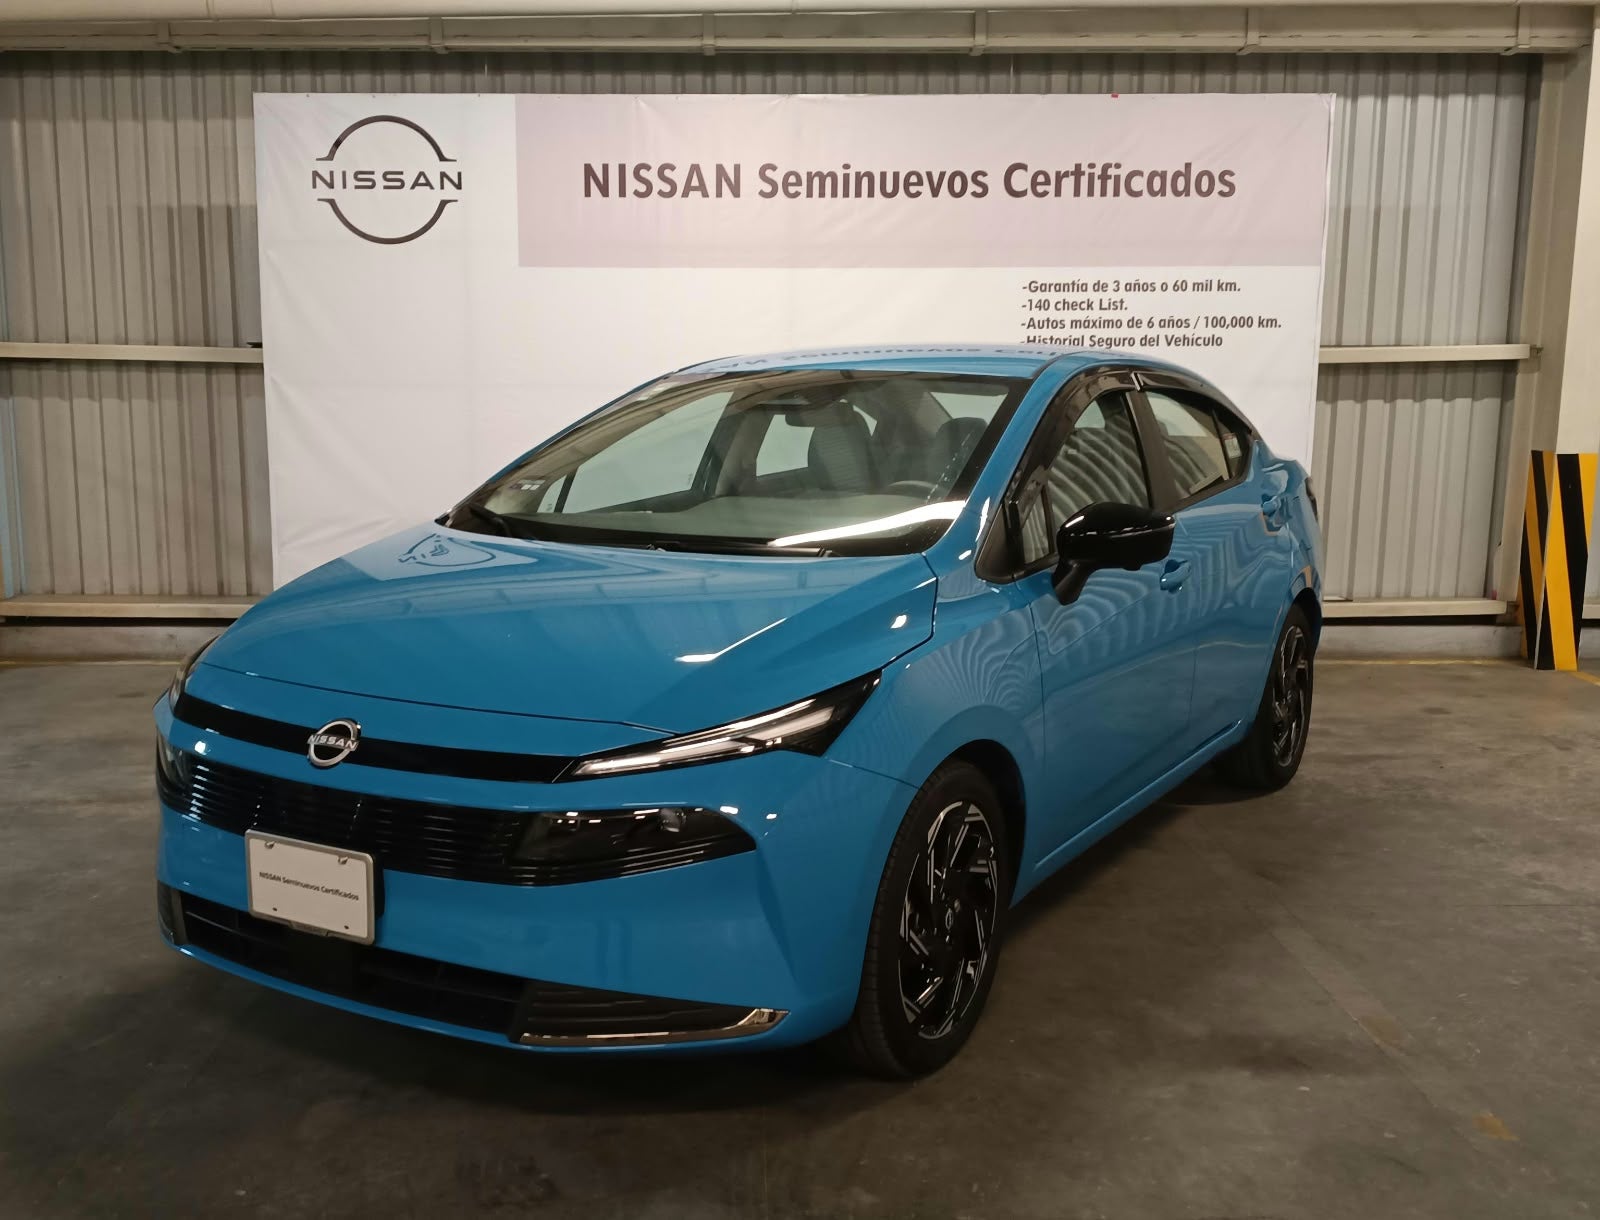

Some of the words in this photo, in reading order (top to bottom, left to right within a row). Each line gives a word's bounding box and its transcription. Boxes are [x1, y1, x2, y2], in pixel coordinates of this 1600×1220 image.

[312, 170, 463, 190] NISSAN
[583, 162, 741, 199] NISSAN
[758, 162, 990, 199] Seminuevos
[1003, 162, 1236, 199] Certificados
[1022, 279, 1089, 294] -Garantía
[1092, 279, 1109, 293] de
[1112, 280, 1121, 293] 3
[1124, 279, 1157, 293] años
[1160, 282, 1169, 293] o
[1172, 280, 1188, 293] 60
[1192, 279, 1213, 293] mil
[1216, 279, 1241, 293] km.
[1021, 298, 1051, 312] -140
[1054, 298, 1094, 312] check
[1099, 298, 1128, 311] List.
[1021, 316, 1066, 330] -Autos
[1069, 315, 1123, 330] máximo
[1126, 315, 1143, 329] de
[1147, 316, 1155, 329] 6
[1158, 316, 1191, 329] años
[1193, 316, 1201, 331] /
[1203, 315, 1254, 330] 100,000
[1257, 315, 1282, 329] km.
[1088, 335, 1136, 349] Seguro
[1139, 334, 1160, 348] del
[1164, 334, 1223, 348] Vehículo
[308, 735, 358, 751] NISSAN
[282, 877, 320, 891] Seminuevos
[320, 886, 359, 900] Certificados
